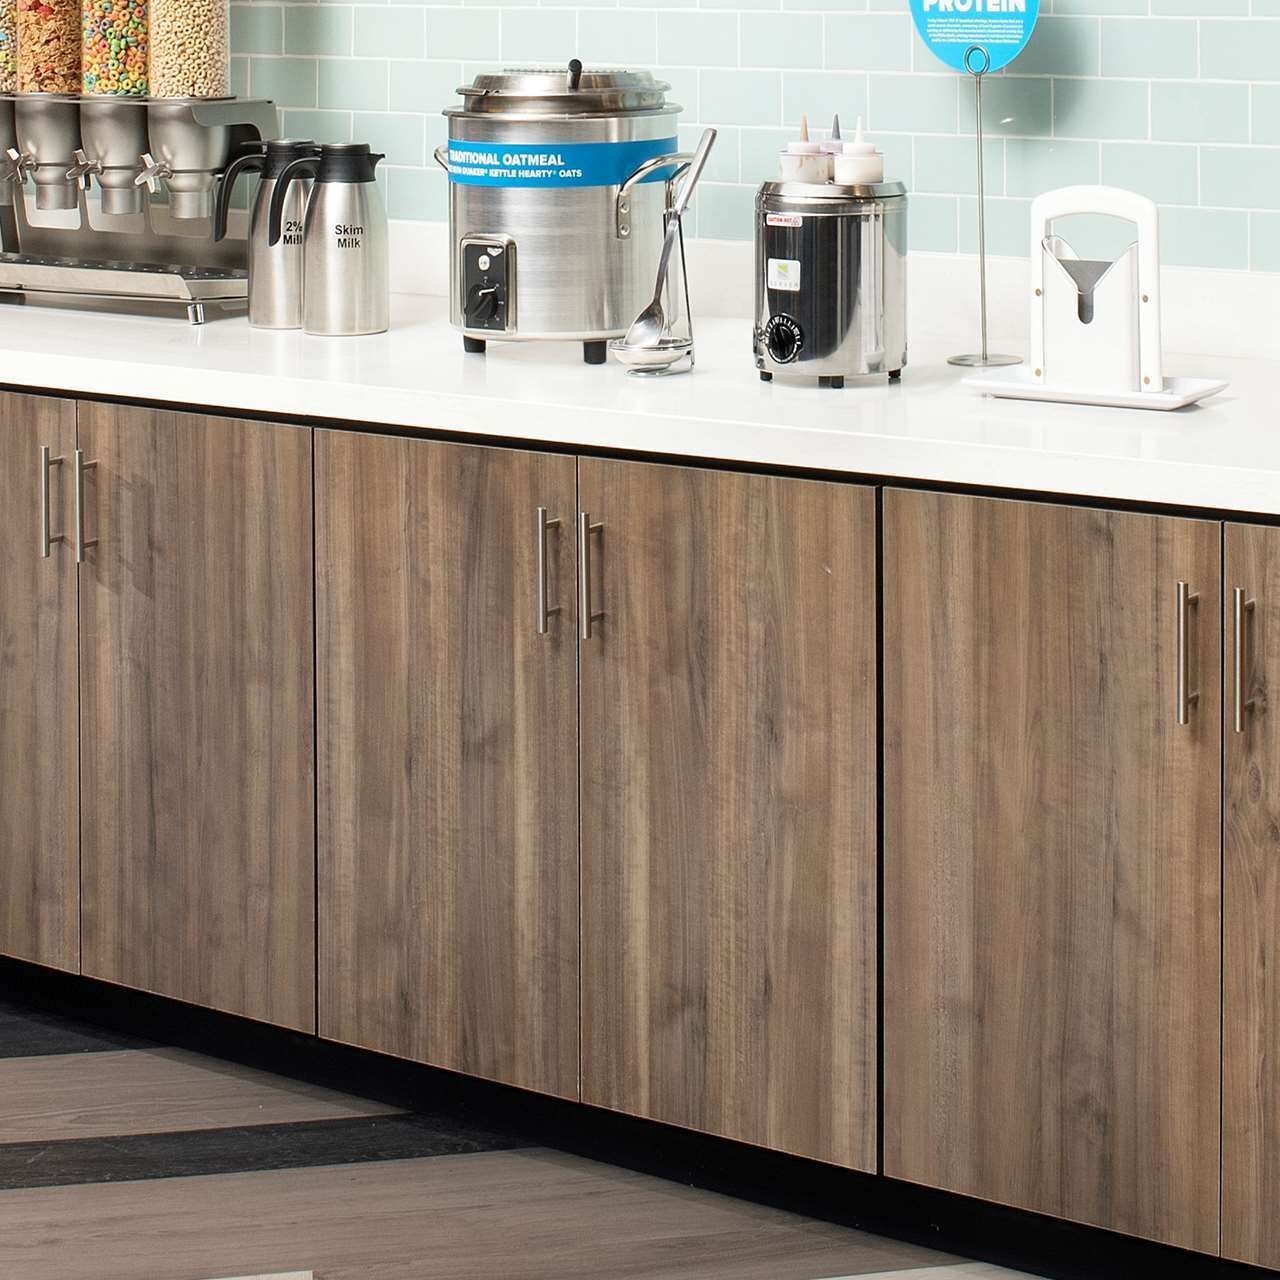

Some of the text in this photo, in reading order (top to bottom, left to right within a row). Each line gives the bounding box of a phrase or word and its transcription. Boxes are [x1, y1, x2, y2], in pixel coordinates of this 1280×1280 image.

[502, 153, 565, 166] OATMEAL
[489, 168, 517, 177] KETTLE
[559, 169, 583, 177] OATS
[334, 224, 363, 235] Skim
[337, 238, 361, 248] Milk
